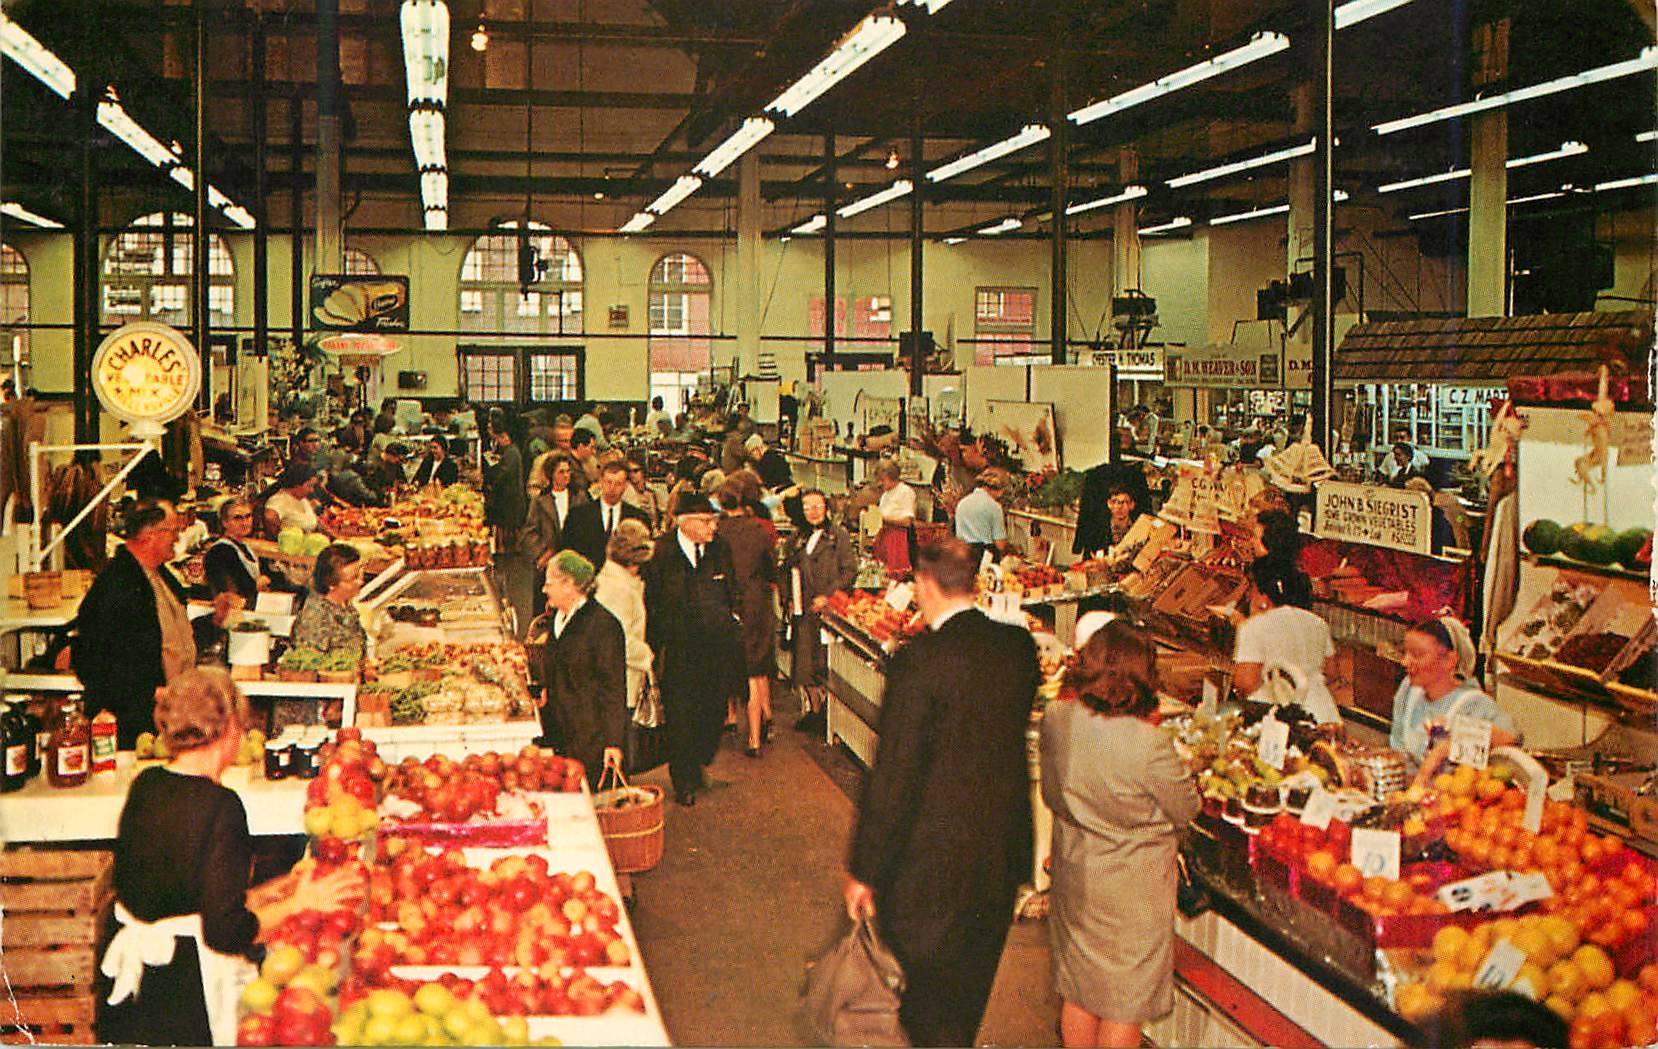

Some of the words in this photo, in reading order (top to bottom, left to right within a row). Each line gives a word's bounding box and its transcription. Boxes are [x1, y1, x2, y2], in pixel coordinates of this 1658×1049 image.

[1126, 352, 1156, 366] THOMAS
[1202, 361, 1235, 375] WEAVER
[1240, 361, 1257, 376] SON
[107, 373, 184, 386] VETABLE
[1325, 494, 1355, 509] JOHN
[1366, 499, 1418, 519] SIEGRIST
[1369, 516, 1416, 533] VEGETABLES
